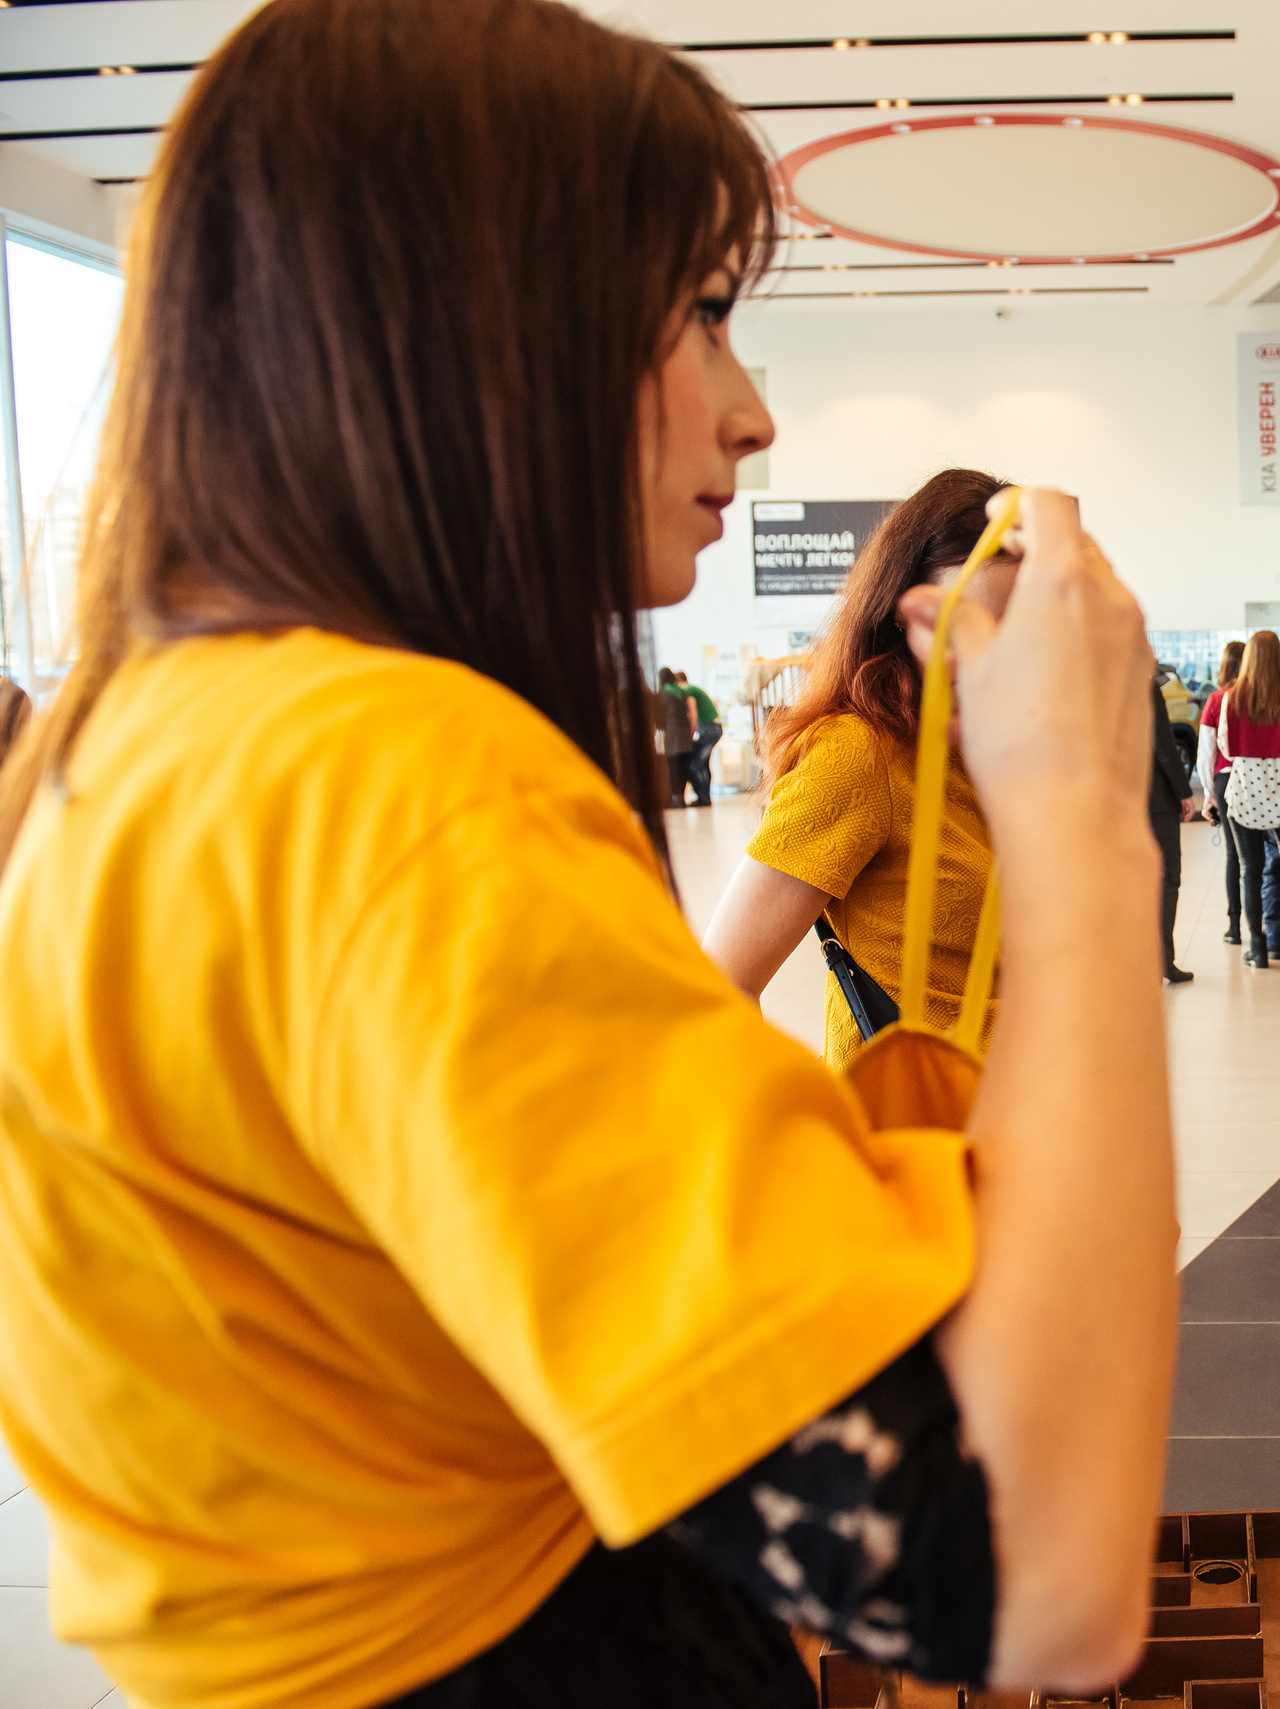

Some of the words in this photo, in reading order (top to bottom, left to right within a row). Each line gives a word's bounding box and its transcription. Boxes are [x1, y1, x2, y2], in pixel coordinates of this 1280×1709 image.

[1259, 381, 1277, 457] УВЕРЕН
[1261, 462, 1277, 493] KIA
[755, 531, 855, 552] ВОПЛОЩАЙ
[756, 553, 803, 568] МЕЧТУ
